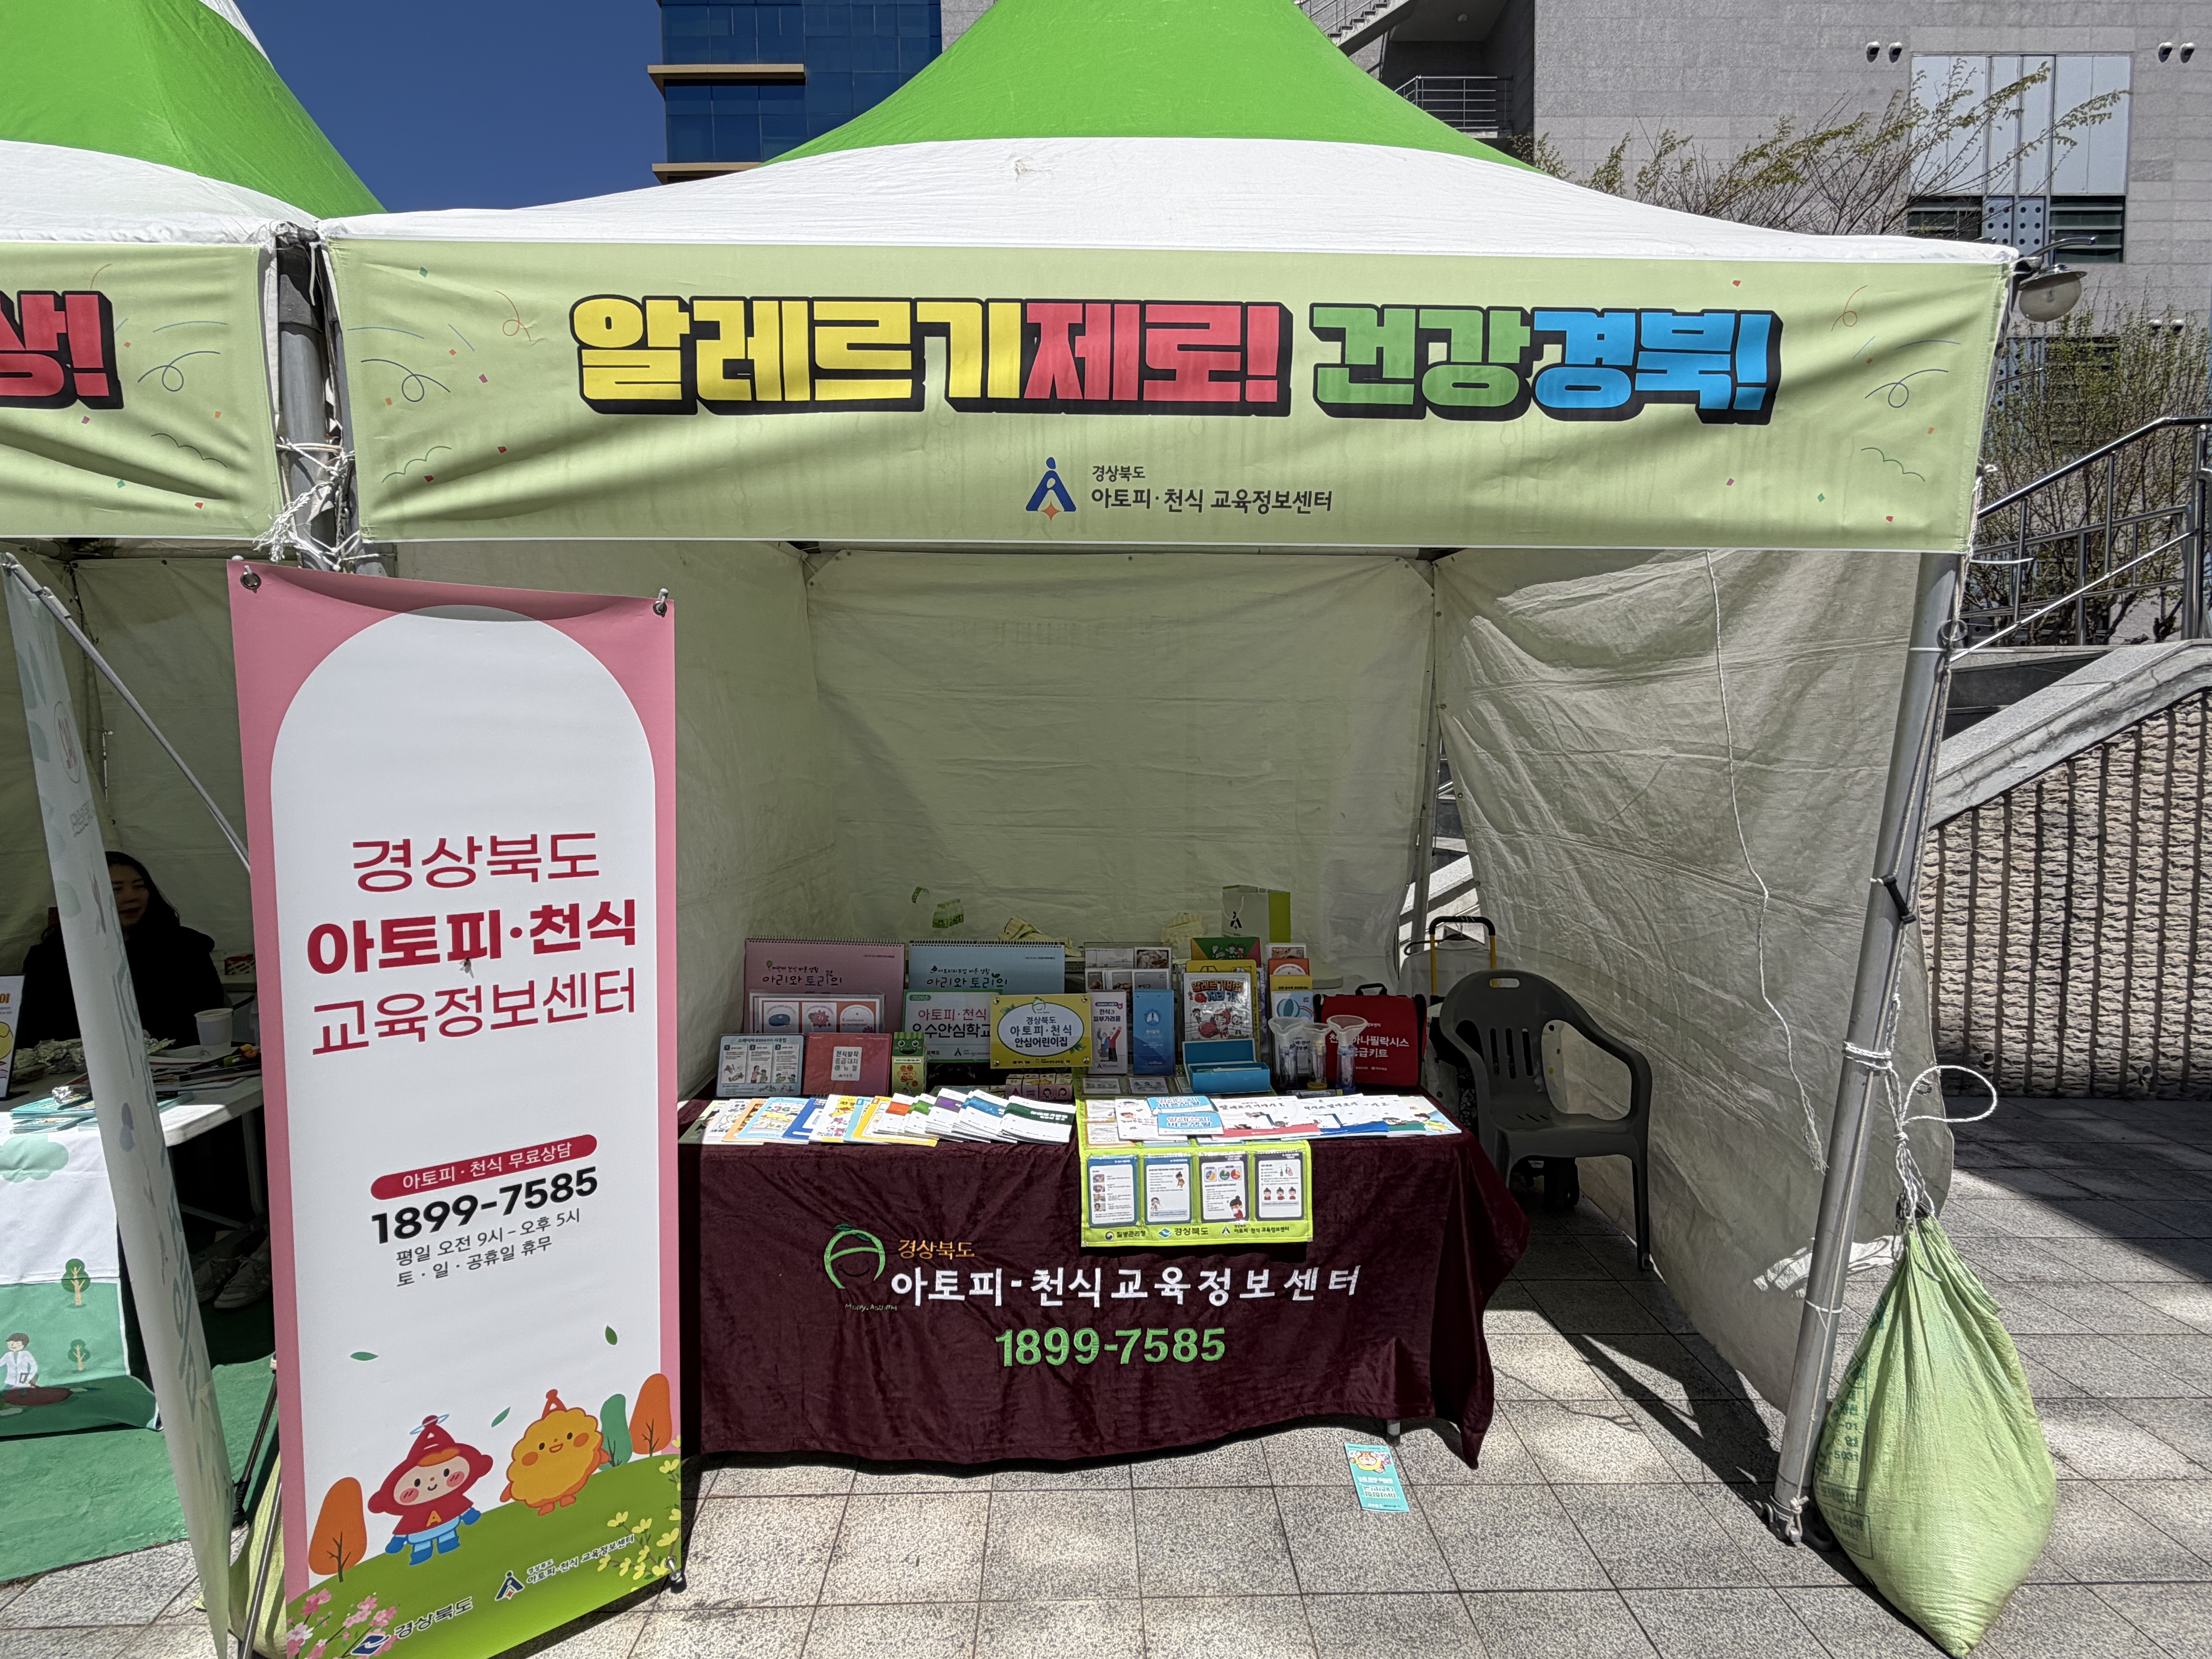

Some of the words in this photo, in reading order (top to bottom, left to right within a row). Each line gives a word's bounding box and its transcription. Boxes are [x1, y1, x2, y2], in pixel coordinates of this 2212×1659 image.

[1092, 465, 1146, 482] 경상북도
[1091, 488, 1204, 513] 아토피·천식
[1211, 489, 1333, 515] 교육정보센터
[352, 833, 599, 892] 경상북도
[307, 899, 635, 974] 아토피·천식
[763, 975, 802, 985] 아리와
[805, 975, 842, 986] 토리의
[927, 977, 967, 988] 아리와
[970, 977, 1007, 988] 토리의
[312, 967, 634, 1055] 교육정보센터
[918, 1009, 986, 1021] 아토피·천식
[1026, 1017, 1056, 1025] 경상북도
[1015, 1037, 1068, 1048] 안심어린이집
[508, 1142, 572, 1168] 무료상담
[371, 1166, 598, 1244] 1899-7585
[396, 1244, 430, 1266] 평일
[437, 1235, 471, 1256] 오전
[477, 1227, 503, 1247] 9시
[520, 1216, 551, 1236] 오후
[556, 1207, 580, 1227] 5시
[1116, 1230, 1146, 1238] 질병관리청
[1174, 1227, 1209, 1236] 경상북도
[521, 1236, 552, 1256] 휴무
[898, 1238, 975, 1261] 경상북도
[1111, 1264, 1360, 1307] 교육정보센터
[996, 1327, 1226, 1367] 1899-7585
[527, 1557, 579, 1583] 아토피·천식
[581, 1534, 634, 1563] 교육정보센터
[527, 1559, 553, 1575] 경상북도
[395, 1596, 473, 1640] 경상북도
